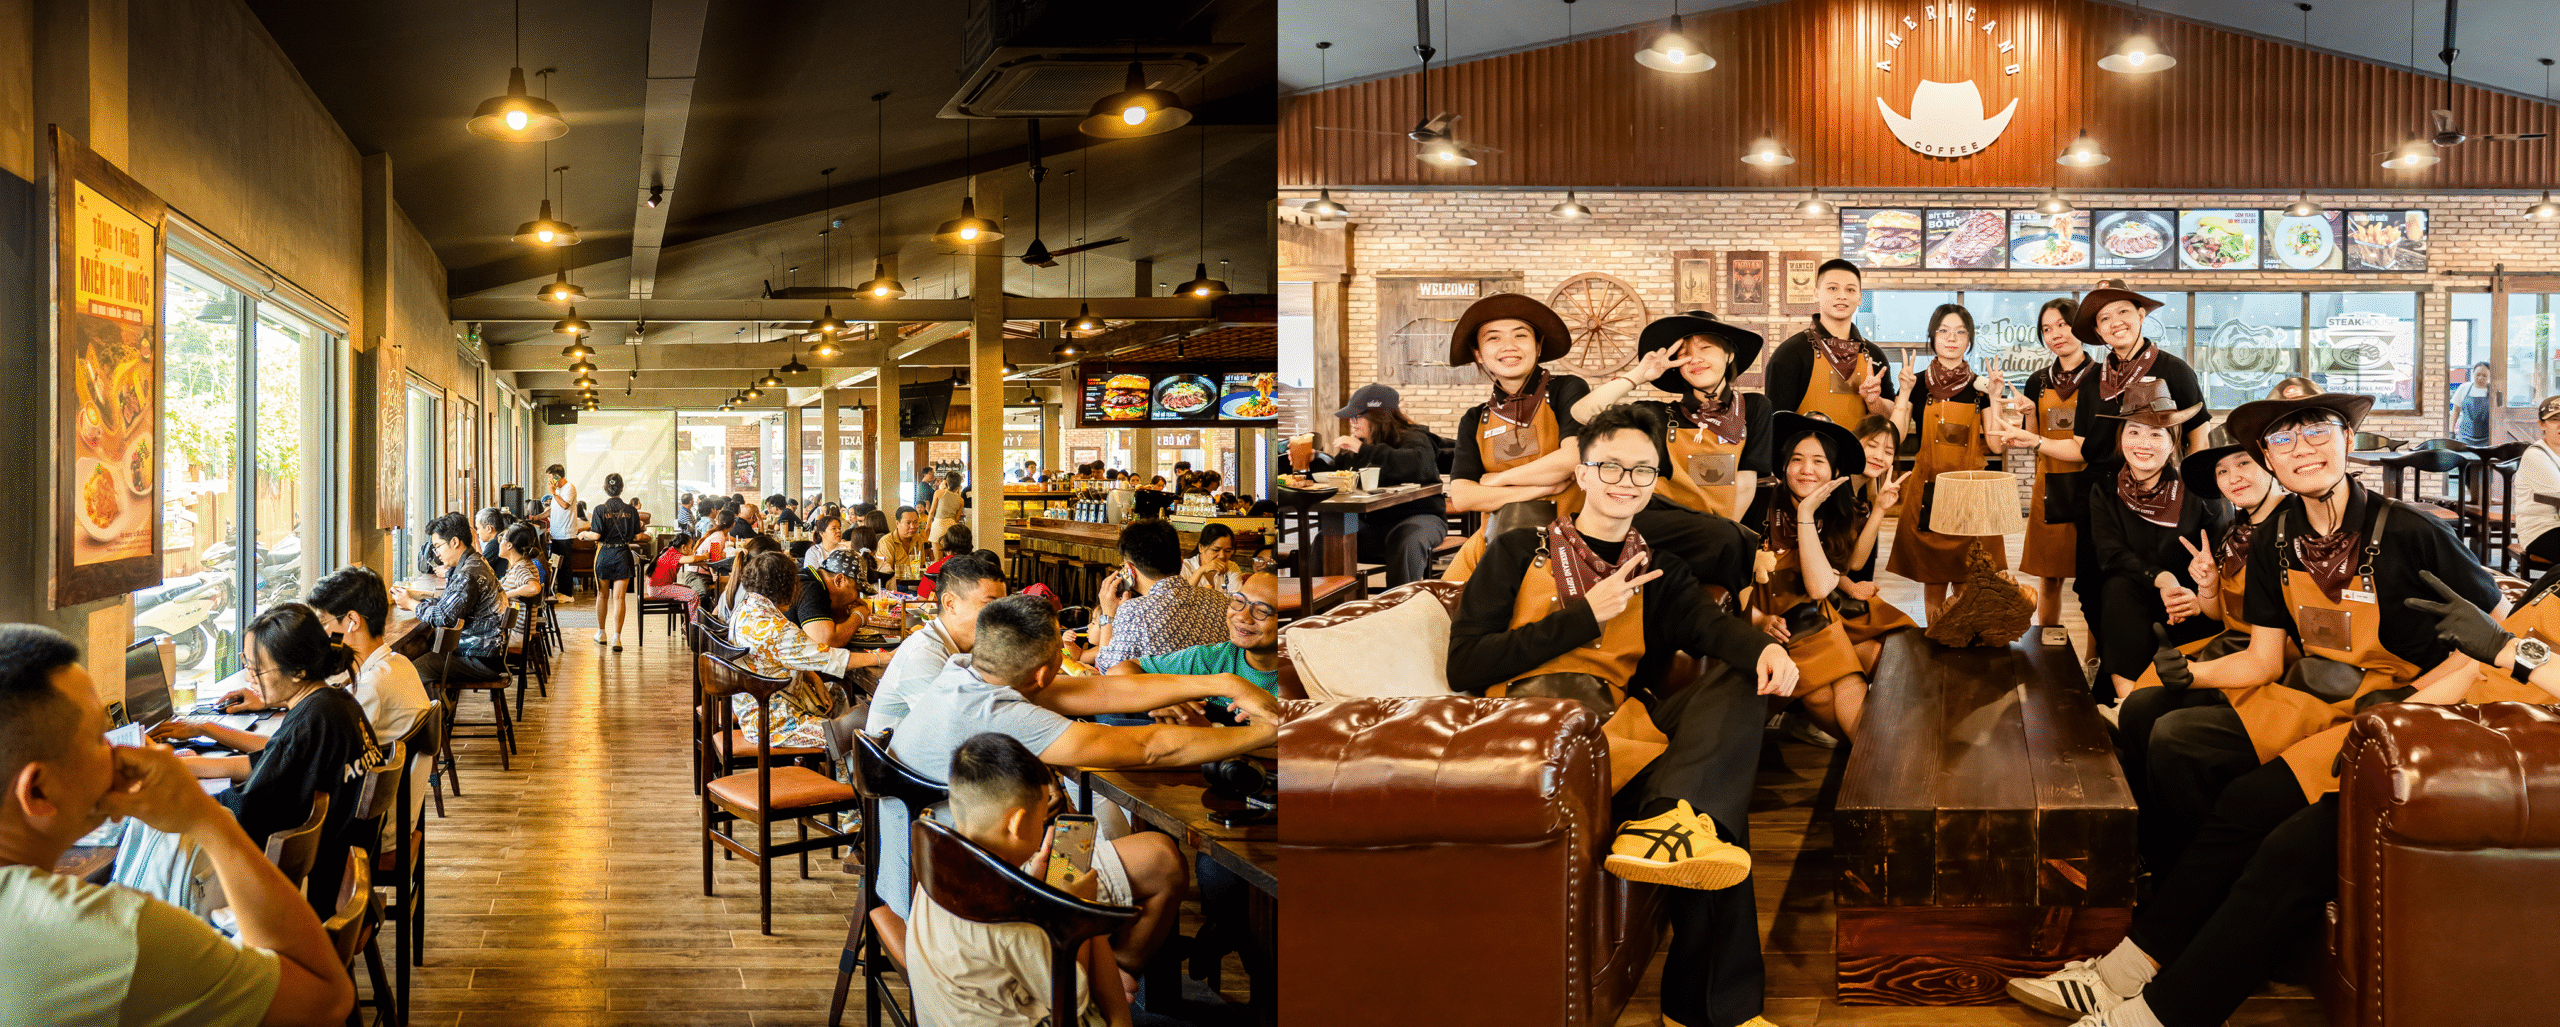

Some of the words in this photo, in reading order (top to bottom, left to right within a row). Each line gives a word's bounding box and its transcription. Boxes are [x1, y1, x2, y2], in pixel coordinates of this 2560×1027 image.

[1876, 3, 2020, 76] AMERICANO
[1914, 141, 1979, 155] COFFEE
[1928, 211, 1941, 220] BÍT
[1942, 209, 1955, 218] TẾT
[1928, 218, 1944, 228] BÒ
[1945, 216, 1961, 227] MỸ
[80, 247, 107, 297] MIỄN
[109, 260, 125, 301] PHÍ
[127, 265, 150, 307] NƯỚC
[1419, 283, 1476, 296] WELCOME
[2328, 318, 2396, 327] STEAKHOUSE
[2012, 343, 2022, 352] is
[1162, 433, 1174, 446] BÒ
[1176, 433, 1191, 446] MỸ
